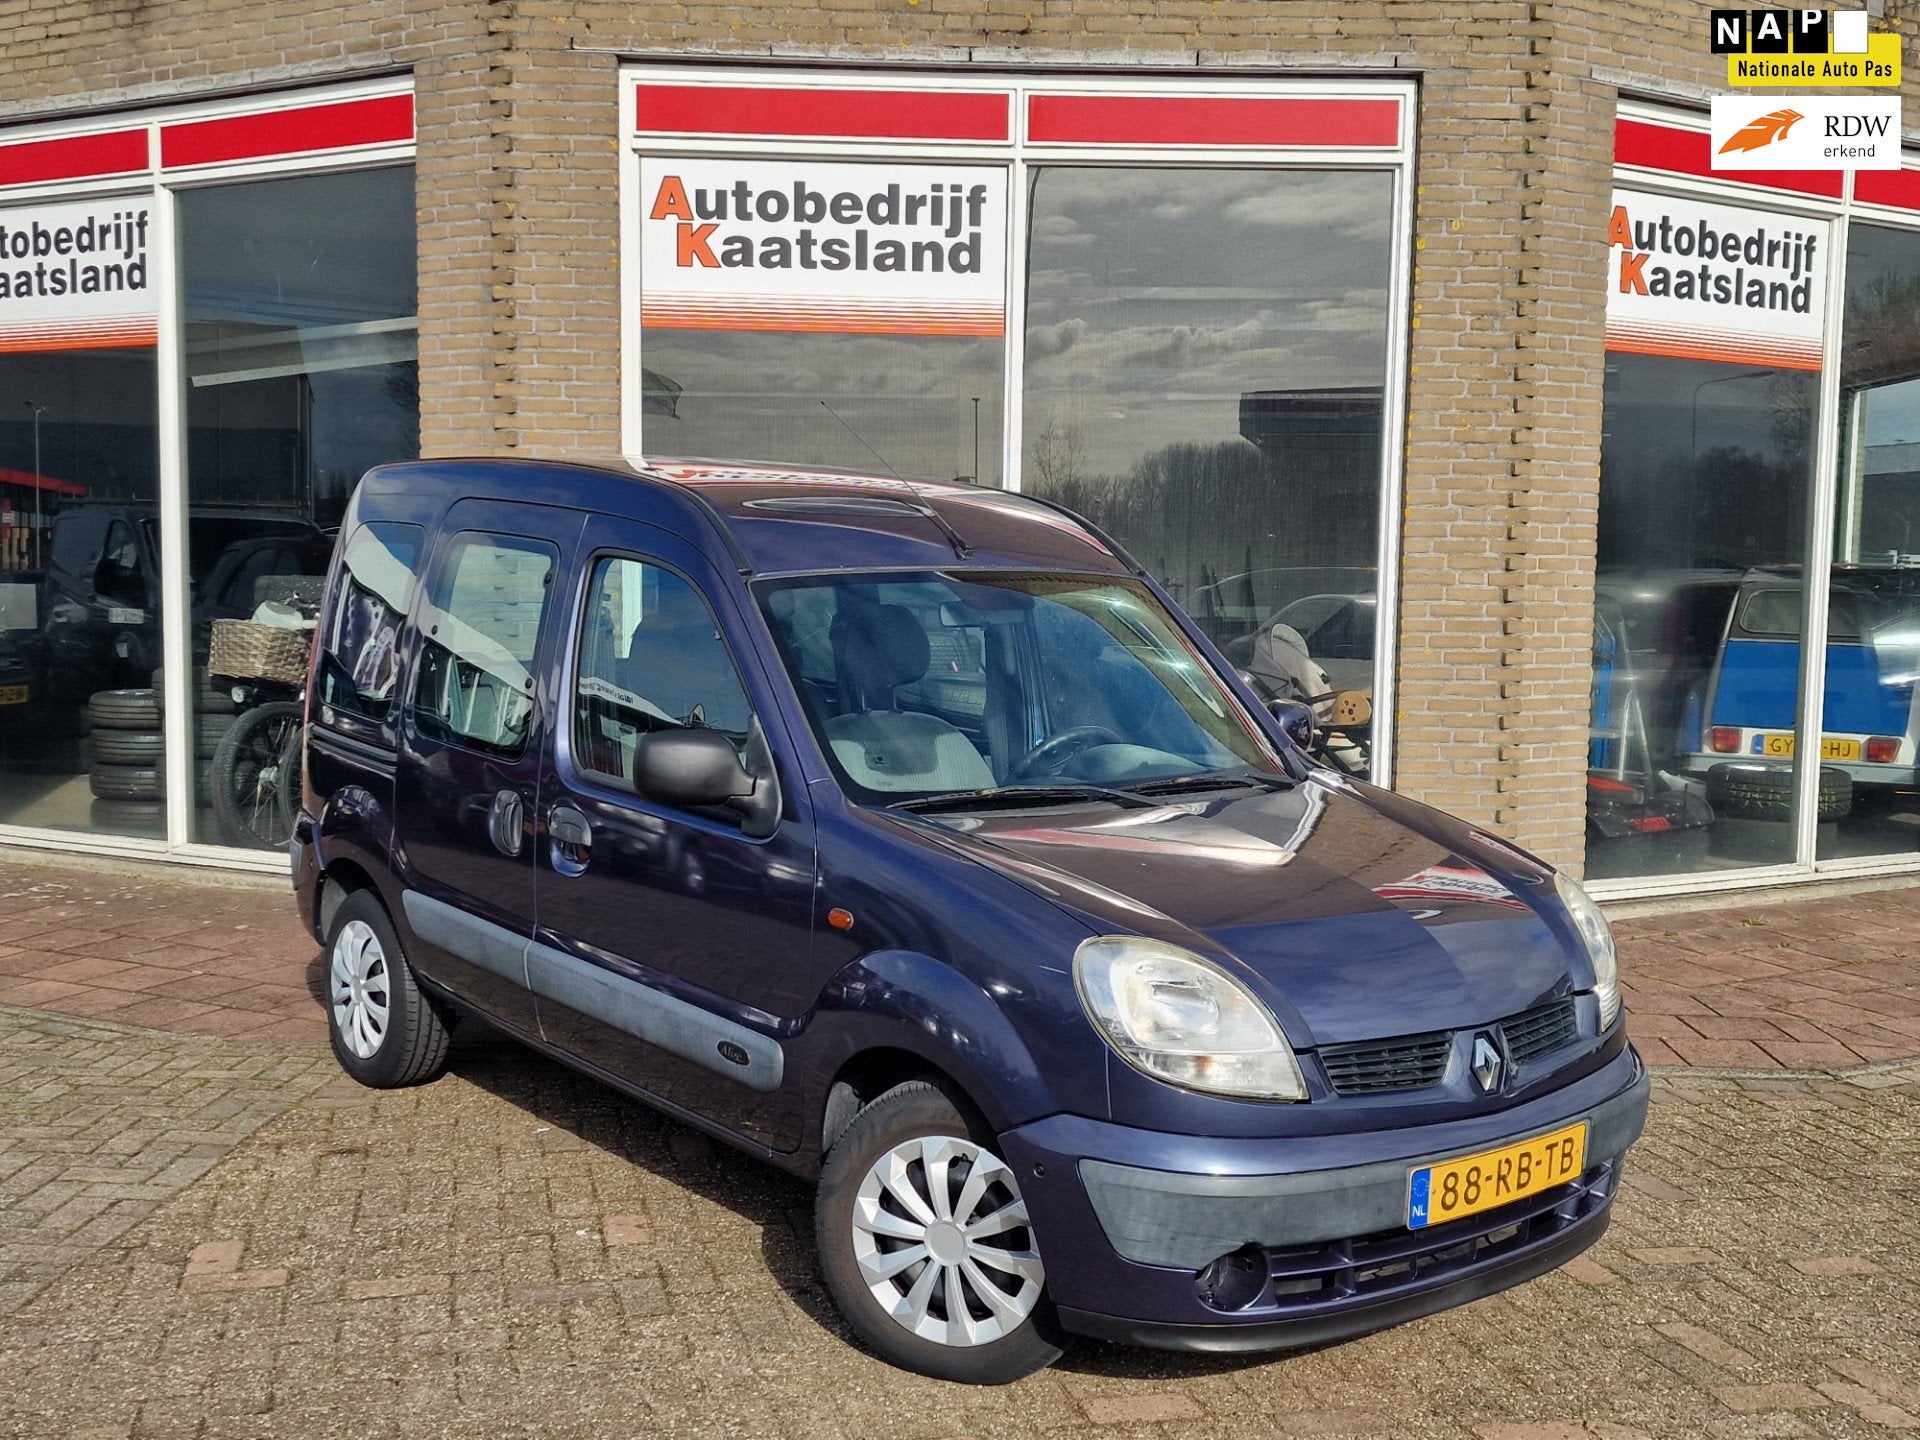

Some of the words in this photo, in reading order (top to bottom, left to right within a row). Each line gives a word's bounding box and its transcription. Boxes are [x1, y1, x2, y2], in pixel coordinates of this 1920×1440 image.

[650, 175, 987, 238] Autobedrijf
[677, 223, 982, 273] Kaatsland
[1609, 205, 1817, 281] Autobedrijf
[1619, 251, 1812, 313] Kaatsland
[1440, 1137, 1575, 1211] 88-RB-TB
[1412, 1205, 1426, 1218] NL
